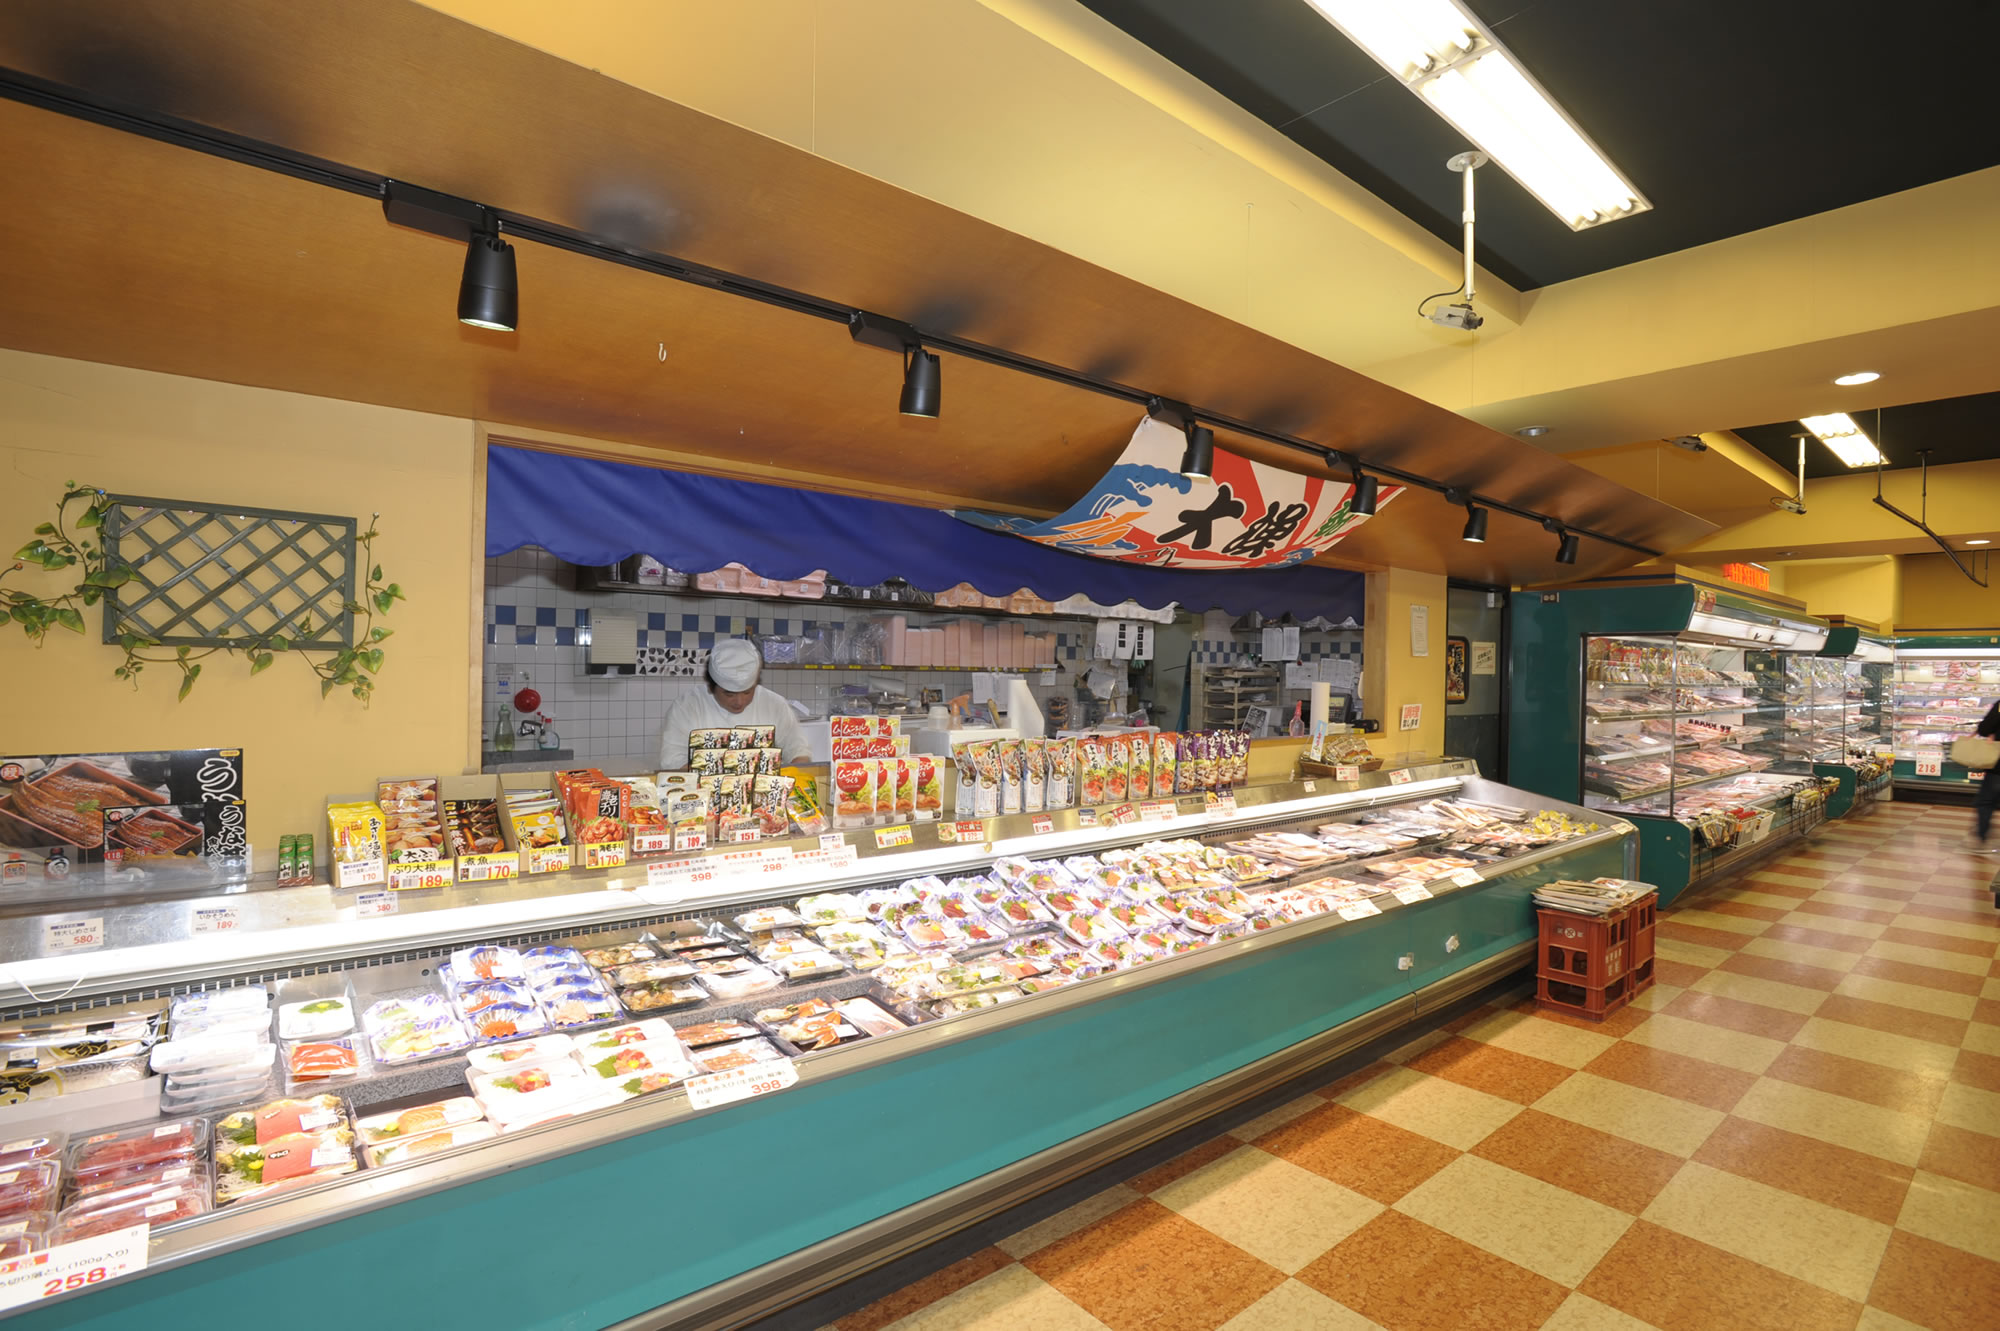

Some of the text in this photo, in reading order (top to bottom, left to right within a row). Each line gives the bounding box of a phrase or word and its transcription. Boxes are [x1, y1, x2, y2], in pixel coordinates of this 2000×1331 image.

[1918, 764, 1936, 773] 218
[741, 832, 755, 840] 151
[648, 840, 663, 849] 189
[464, 857, 489, 866] 煮魚
[545, 860, 562, 872] 160
[600, 855, 619, 866] 170
[393, 863, 437, 874] ぶり大根
[487, 865, 510, 879] 170
[763, 863, 782, 872] 298
[419, 875, 443, 888] 189
[691, 872, 712, 883] 398
[216, 920, 233, 930] 189
[73, 934, 93, 945] 580
[751, 1079, 782, 1094] 398
[43, 1267, 107, 1296] 258
